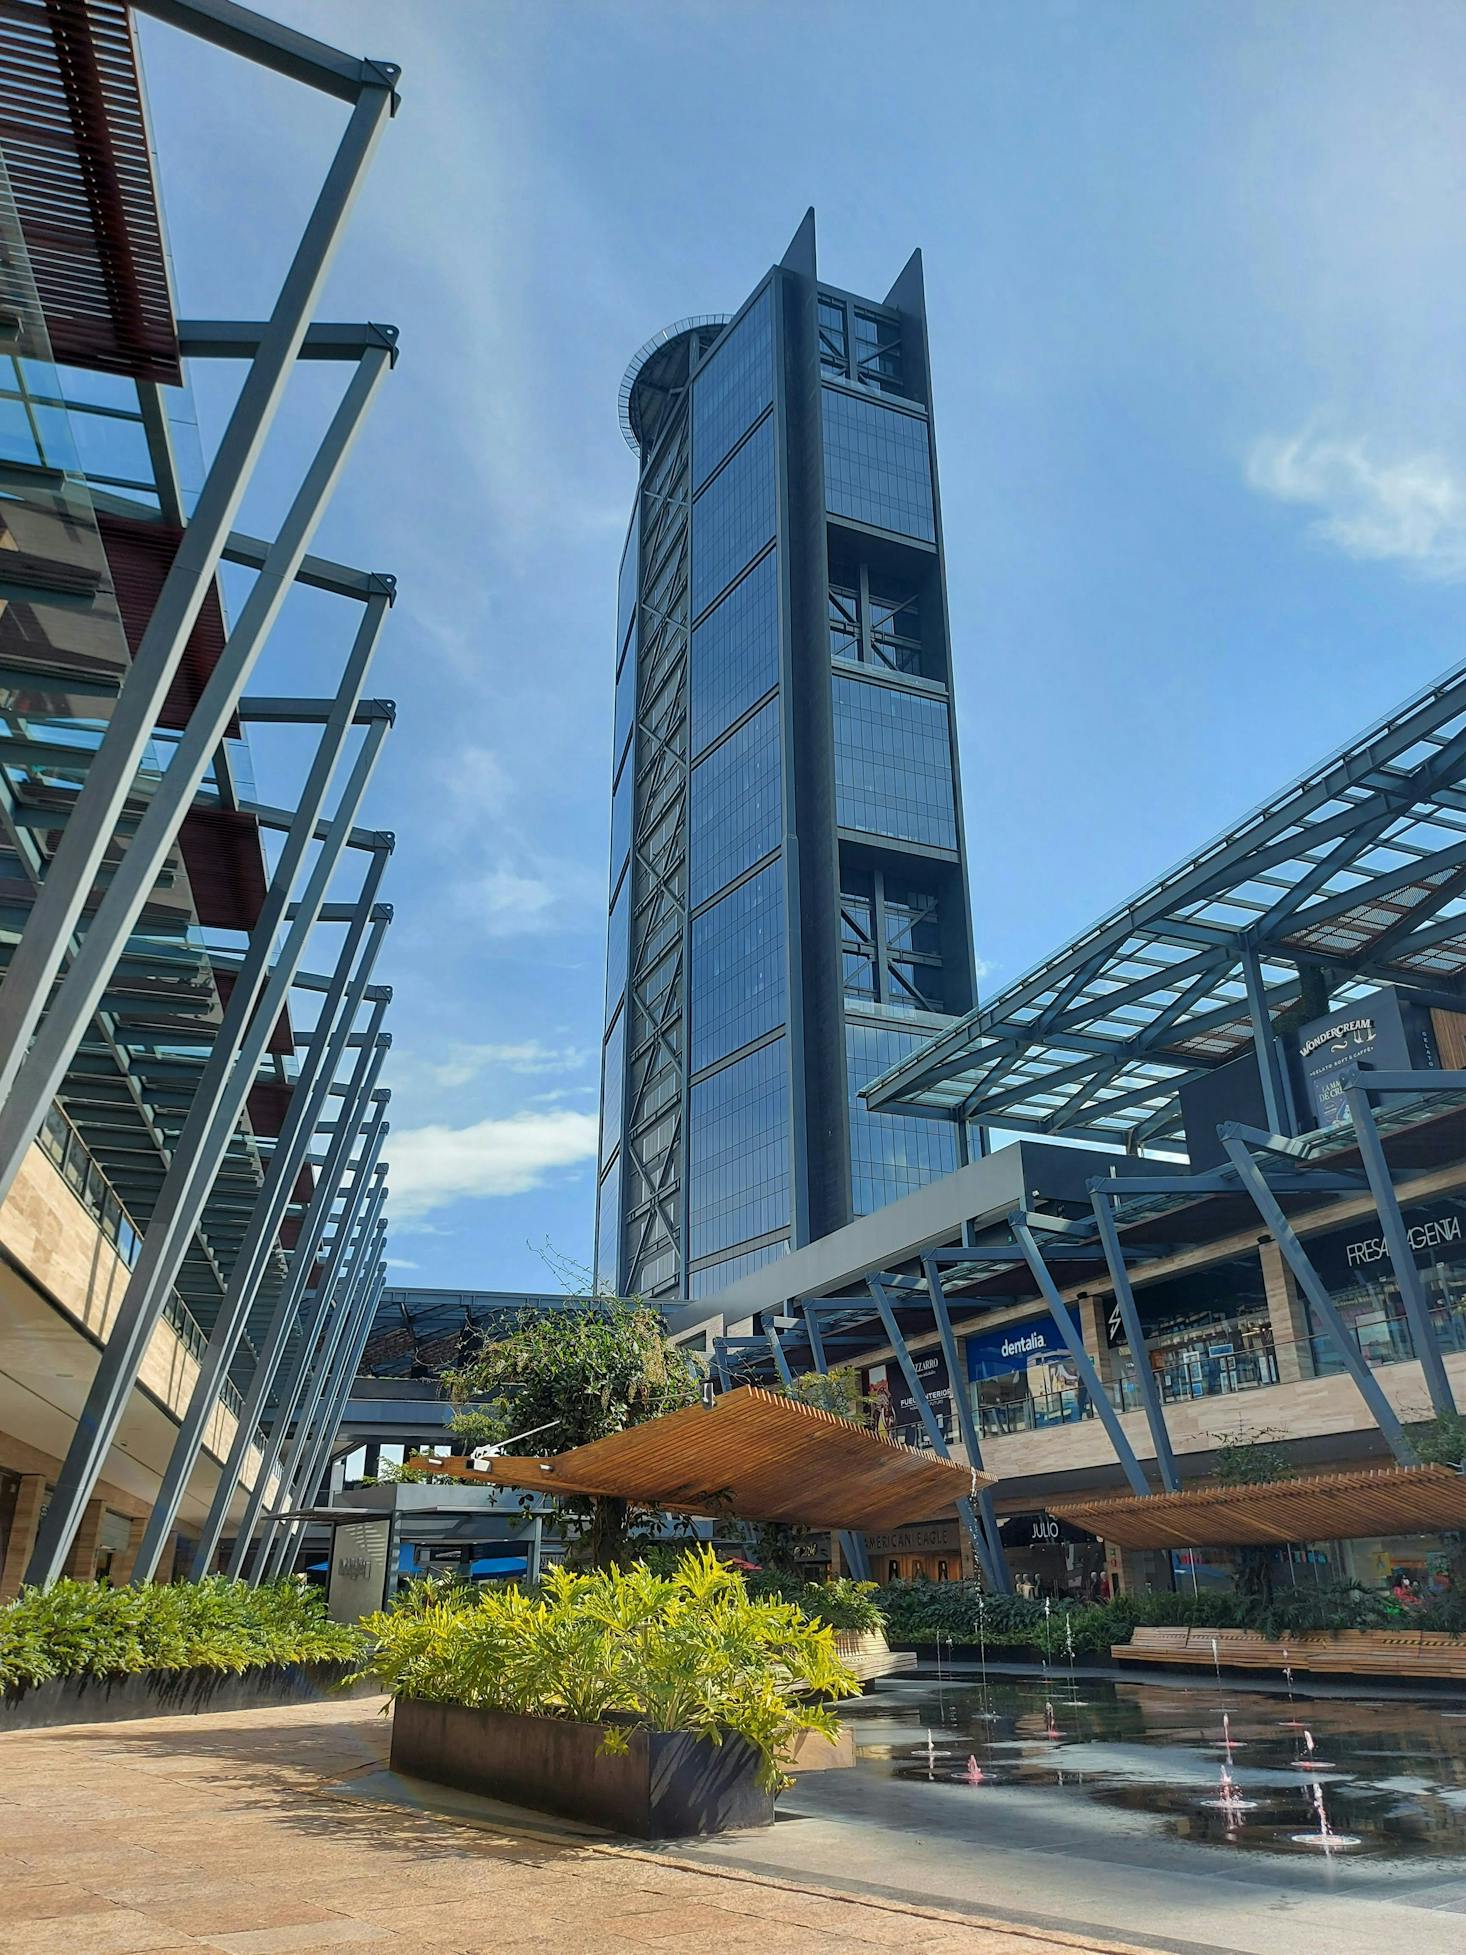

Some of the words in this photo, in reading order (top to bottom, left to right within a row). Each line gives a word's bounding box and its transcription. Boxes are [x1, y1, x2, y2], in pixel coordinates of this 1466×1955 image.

[1300, 1019, 1371, 1057] WONDERCREAM
[1422, 1031, 1434, 1067] GELATO
[1346, 1237, 1390, 1267] FRESA
[1406, 1216, 1462, 1250] AGENTA
[1001, 1331, 1045, 1358] dentalia
[913, 1357, 939, 1373] ZZARRO
[916, 1529, 949, 1547] EAGLE
[1031, 1521, 1059, 1539] JULIO
